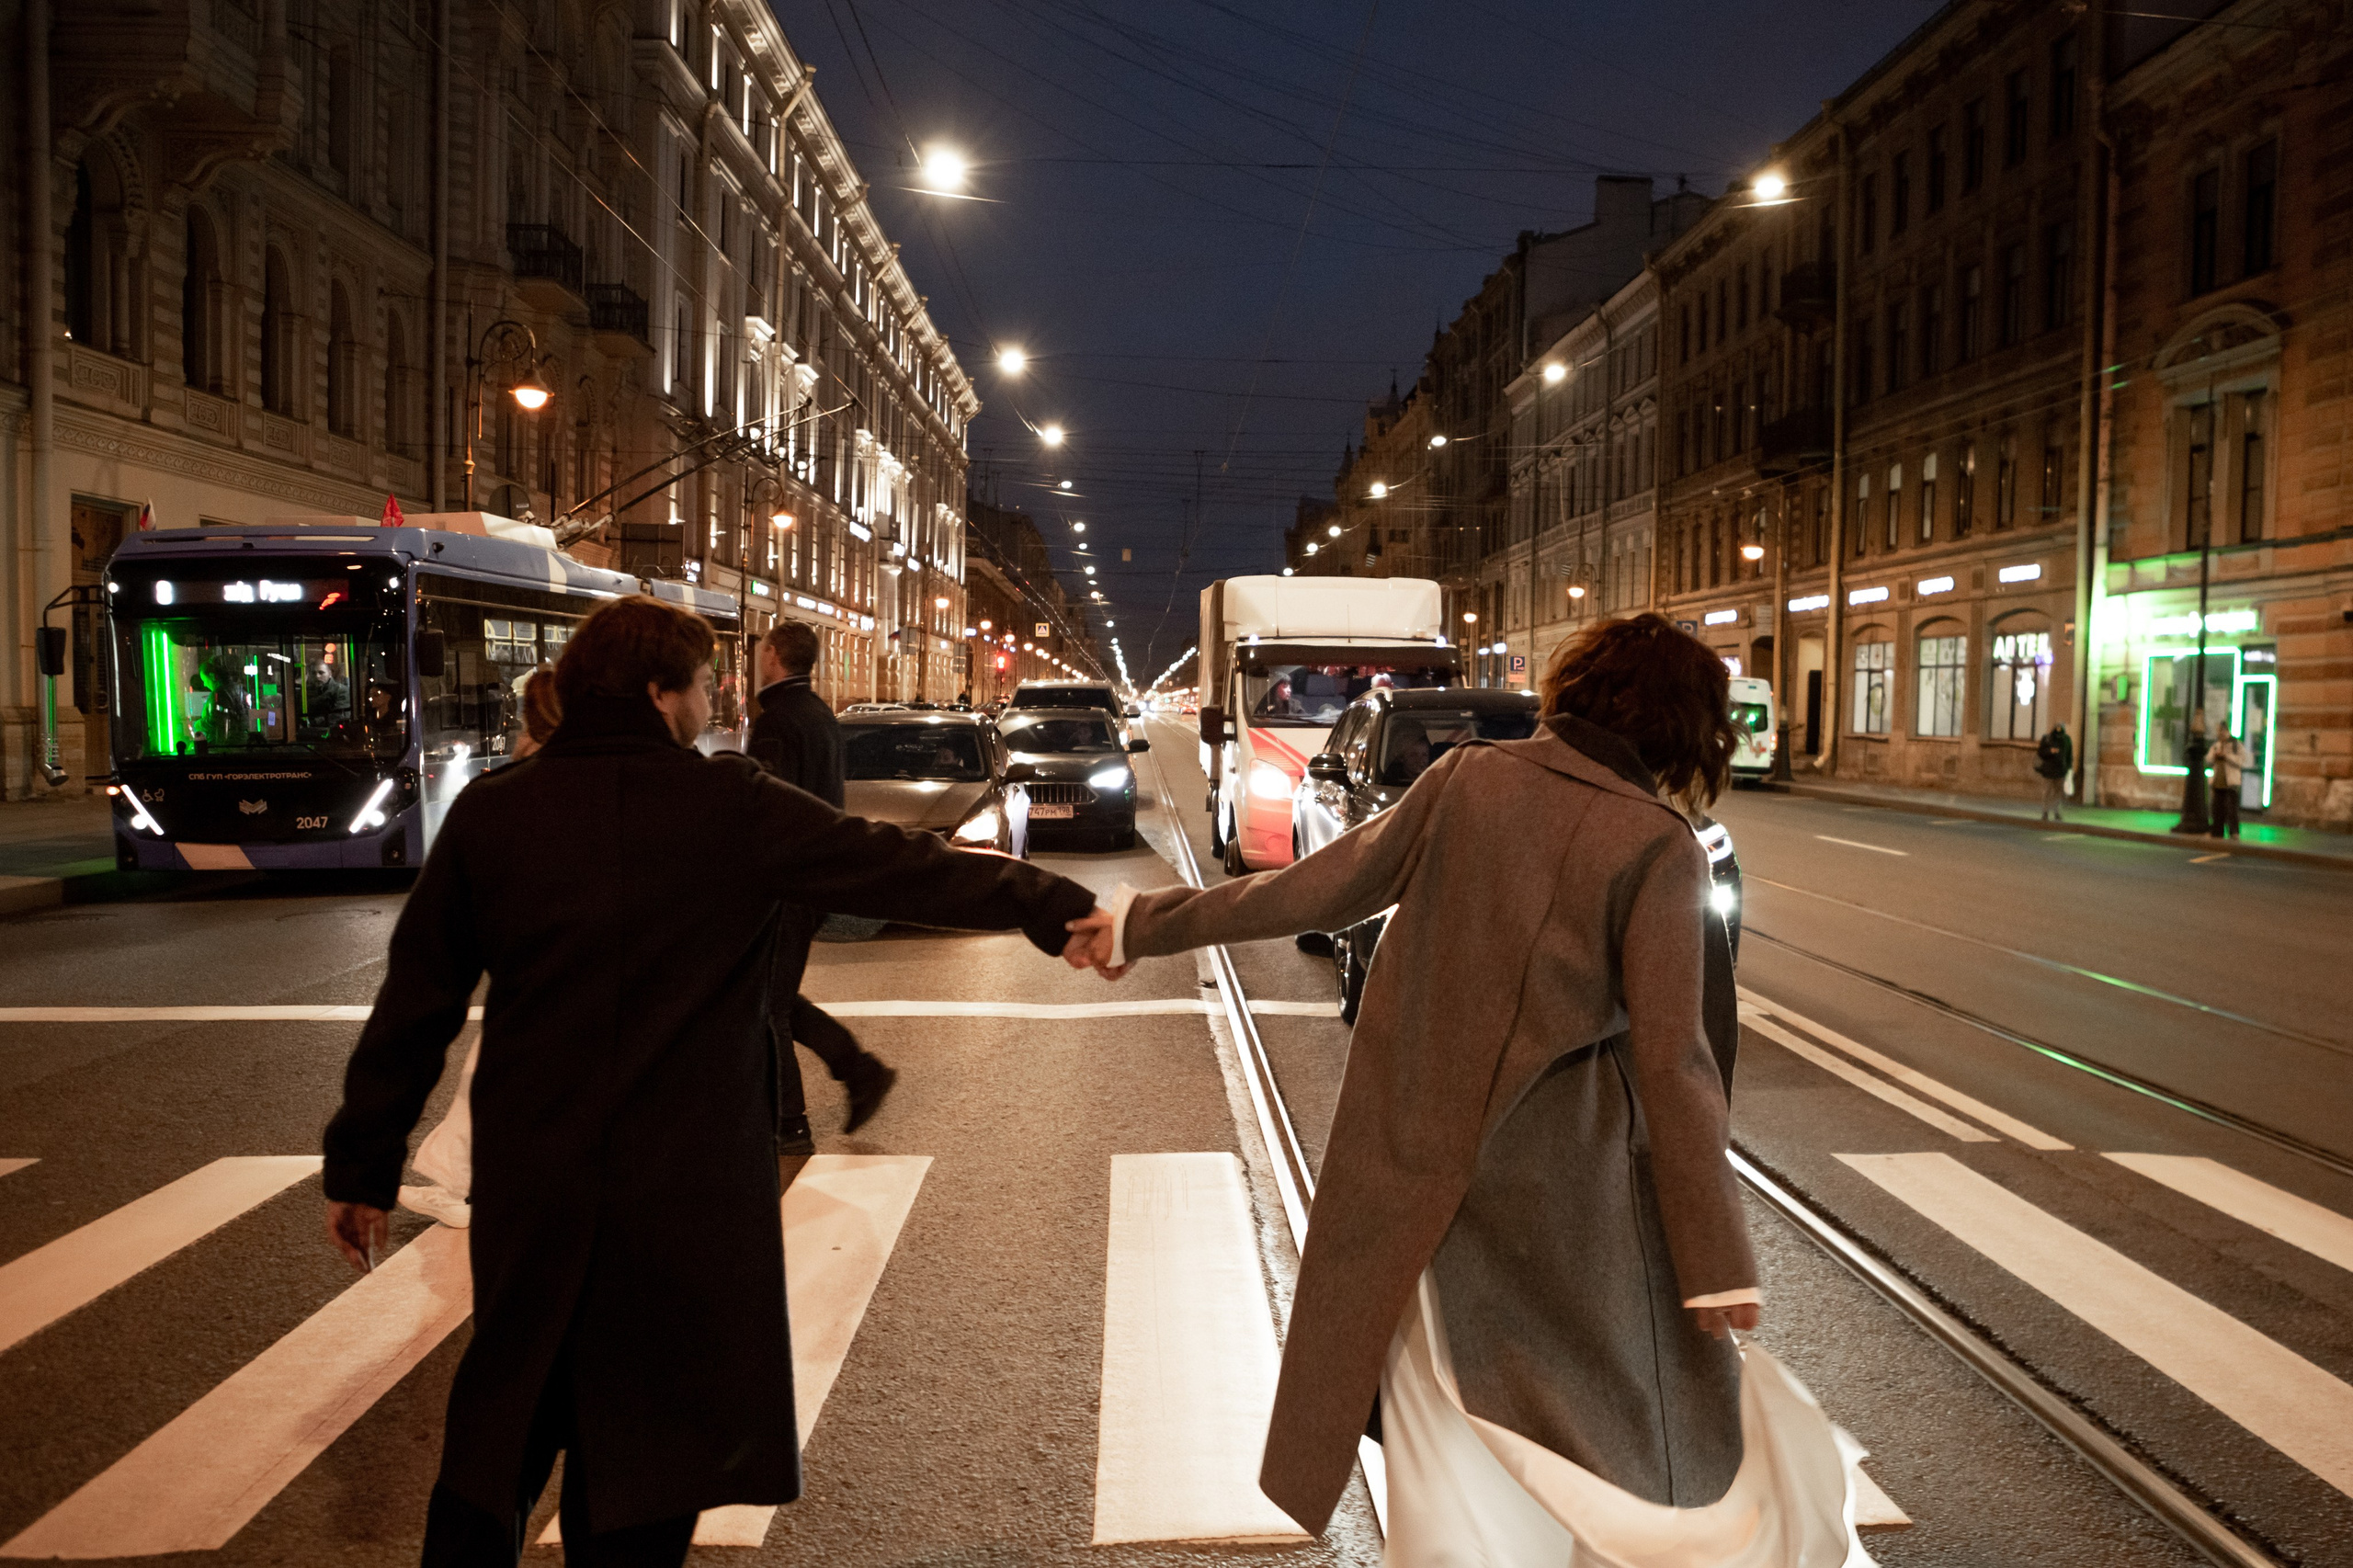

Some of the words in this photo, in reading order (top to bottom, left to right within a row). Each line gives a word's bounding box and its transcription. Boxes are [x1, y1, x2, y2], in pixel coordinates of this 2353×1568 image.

[1993, 633, 2051, 659] АПТЕК
[1029, 807, 1057, 816] 747РМ
[295, 816, 329, 829] 2047
